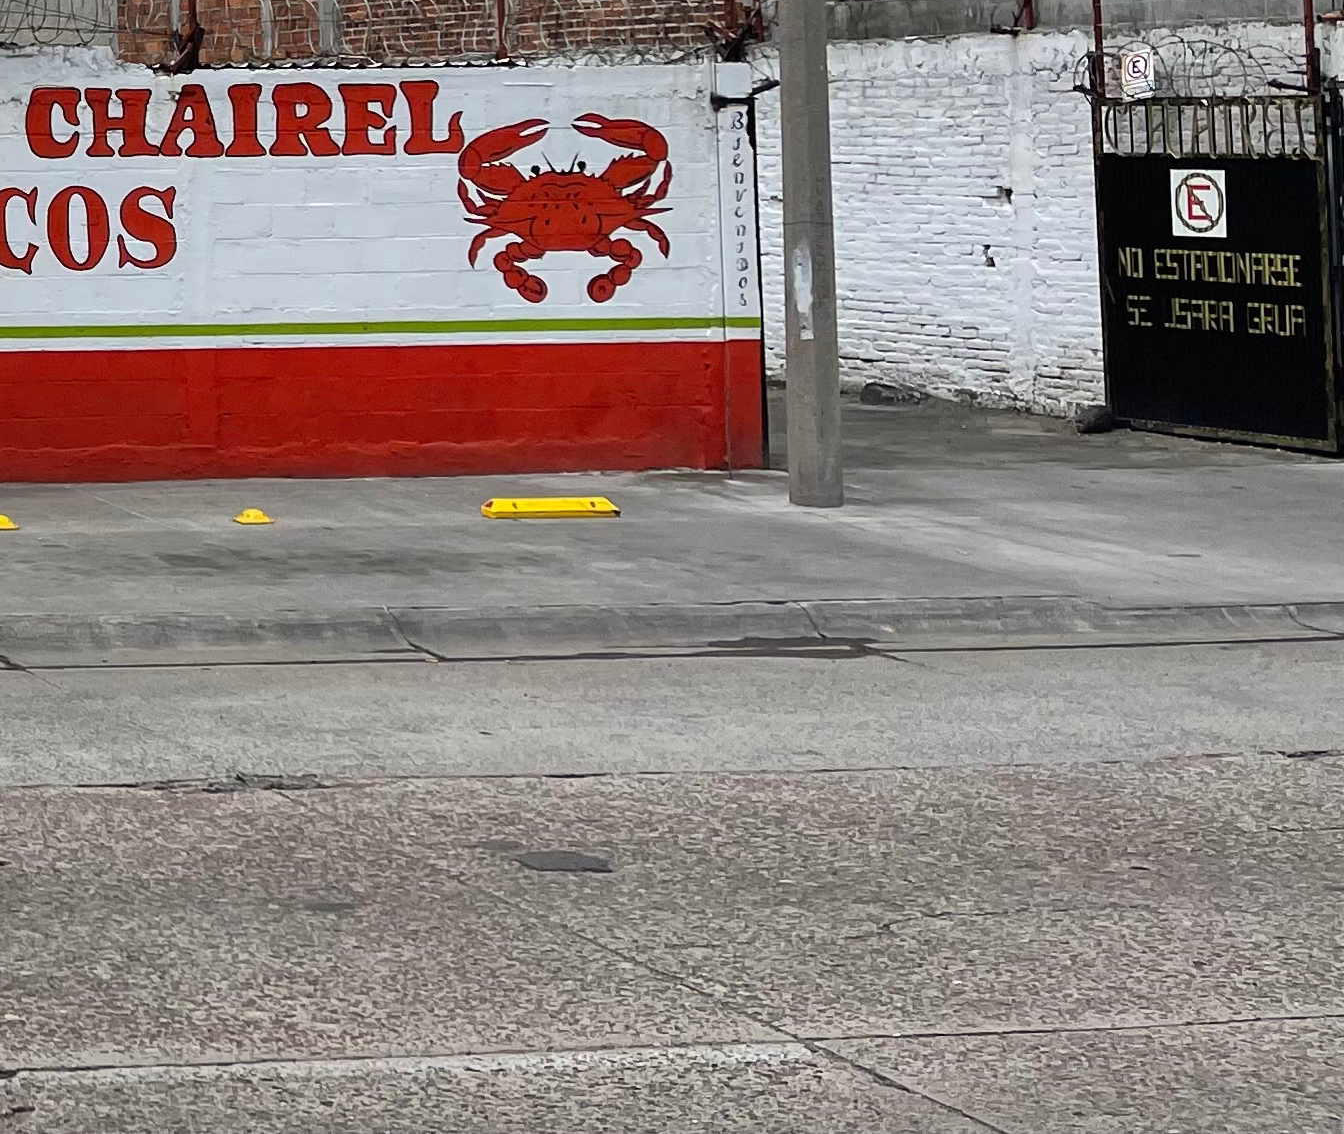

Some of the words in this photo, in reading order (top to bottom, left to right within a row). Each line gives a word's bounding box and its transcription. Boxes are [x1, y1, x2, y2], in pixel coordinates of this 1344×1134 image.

[24, 80, 466, 160] CHAIREL
[1186, 184, 1212, 221] E
[1118, 246, 1143, 279] NO
[1154, 248, 1303, 288] ESTACIONARSE
[1126, 294, 1153, 327] SE
[1246, 301, 1307, 337] GRUA
